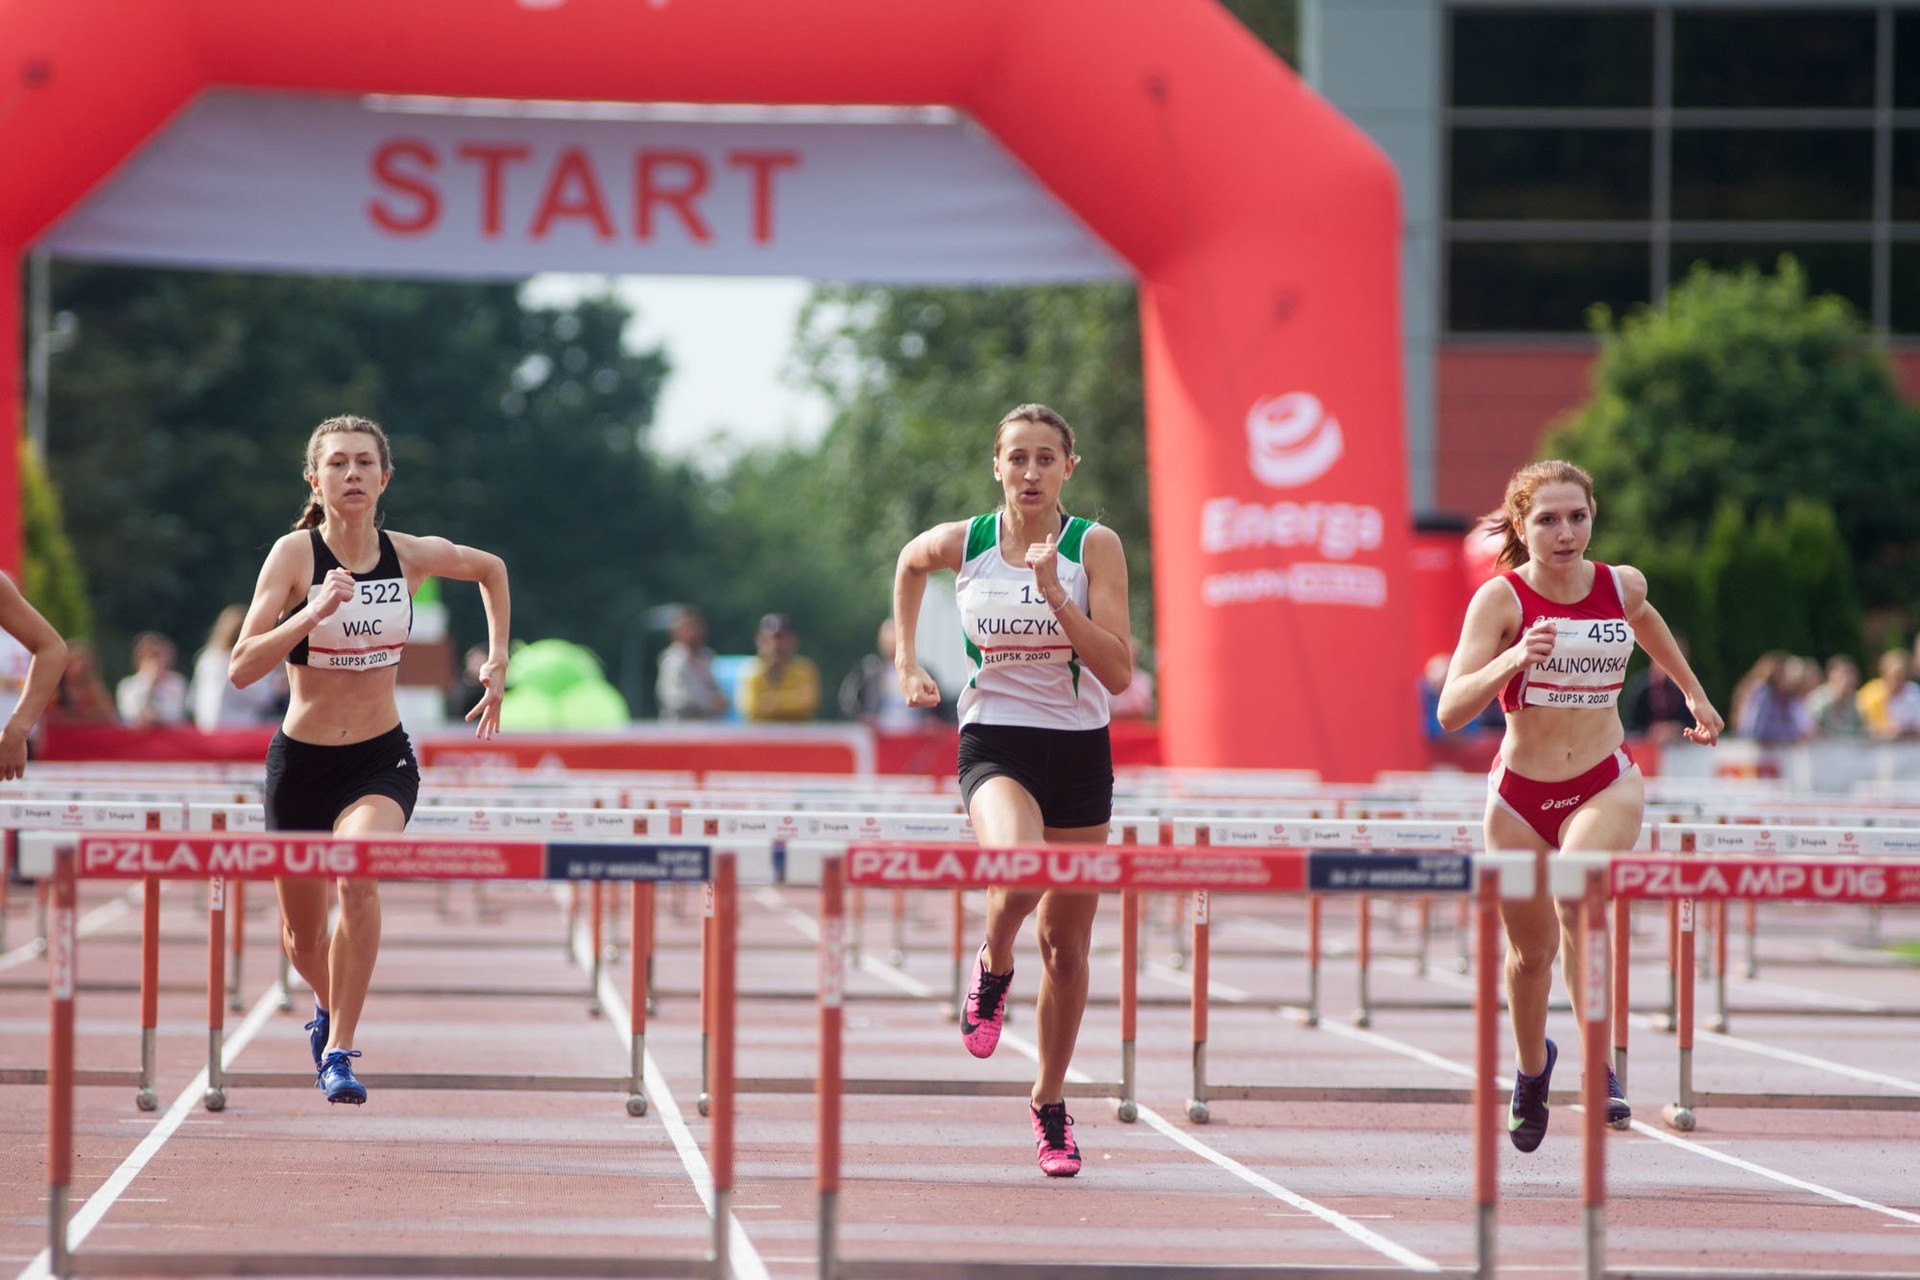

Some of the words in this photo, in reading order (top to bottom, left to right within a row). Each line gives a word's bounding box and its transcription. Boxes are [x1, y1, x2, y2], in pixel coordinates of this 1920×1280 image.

[367, 137, 803, 247] START
[1201, 496, 1384, 559] Energa
[361, 582, 401, 605] 522
[343, 619, 383, 637] WAC
[977, 618, 1059, 636] KULCZYK
[1588, 623, 1627, 643] 455
[330, 656, 367, 666] SŁUPSK
[369, 652, 388, 664] 2020
[985, 652, 1022, 664] SŁUPSK
[1025, 651, 1051, 661] 2020
[1548, 693, 1584, 704] SŁUPSK
[1588, 694, 1609, 704] 2020
[1554, 795, 1581, 808] asics
[86, 843, 198, 872] PZLA
[208, 844, 277, 872] MP
[284, 845, 357, 873] U16
[852, 852, 966, 881] PZLA
[973, 854, 1043, 881] MP
[1048, 854, 1123, 883] U16
[1615, 865, 1729, 894] PZLA
[1738, 866, 1806, 894] MP
[1812, 867, 1887, 897] U16
